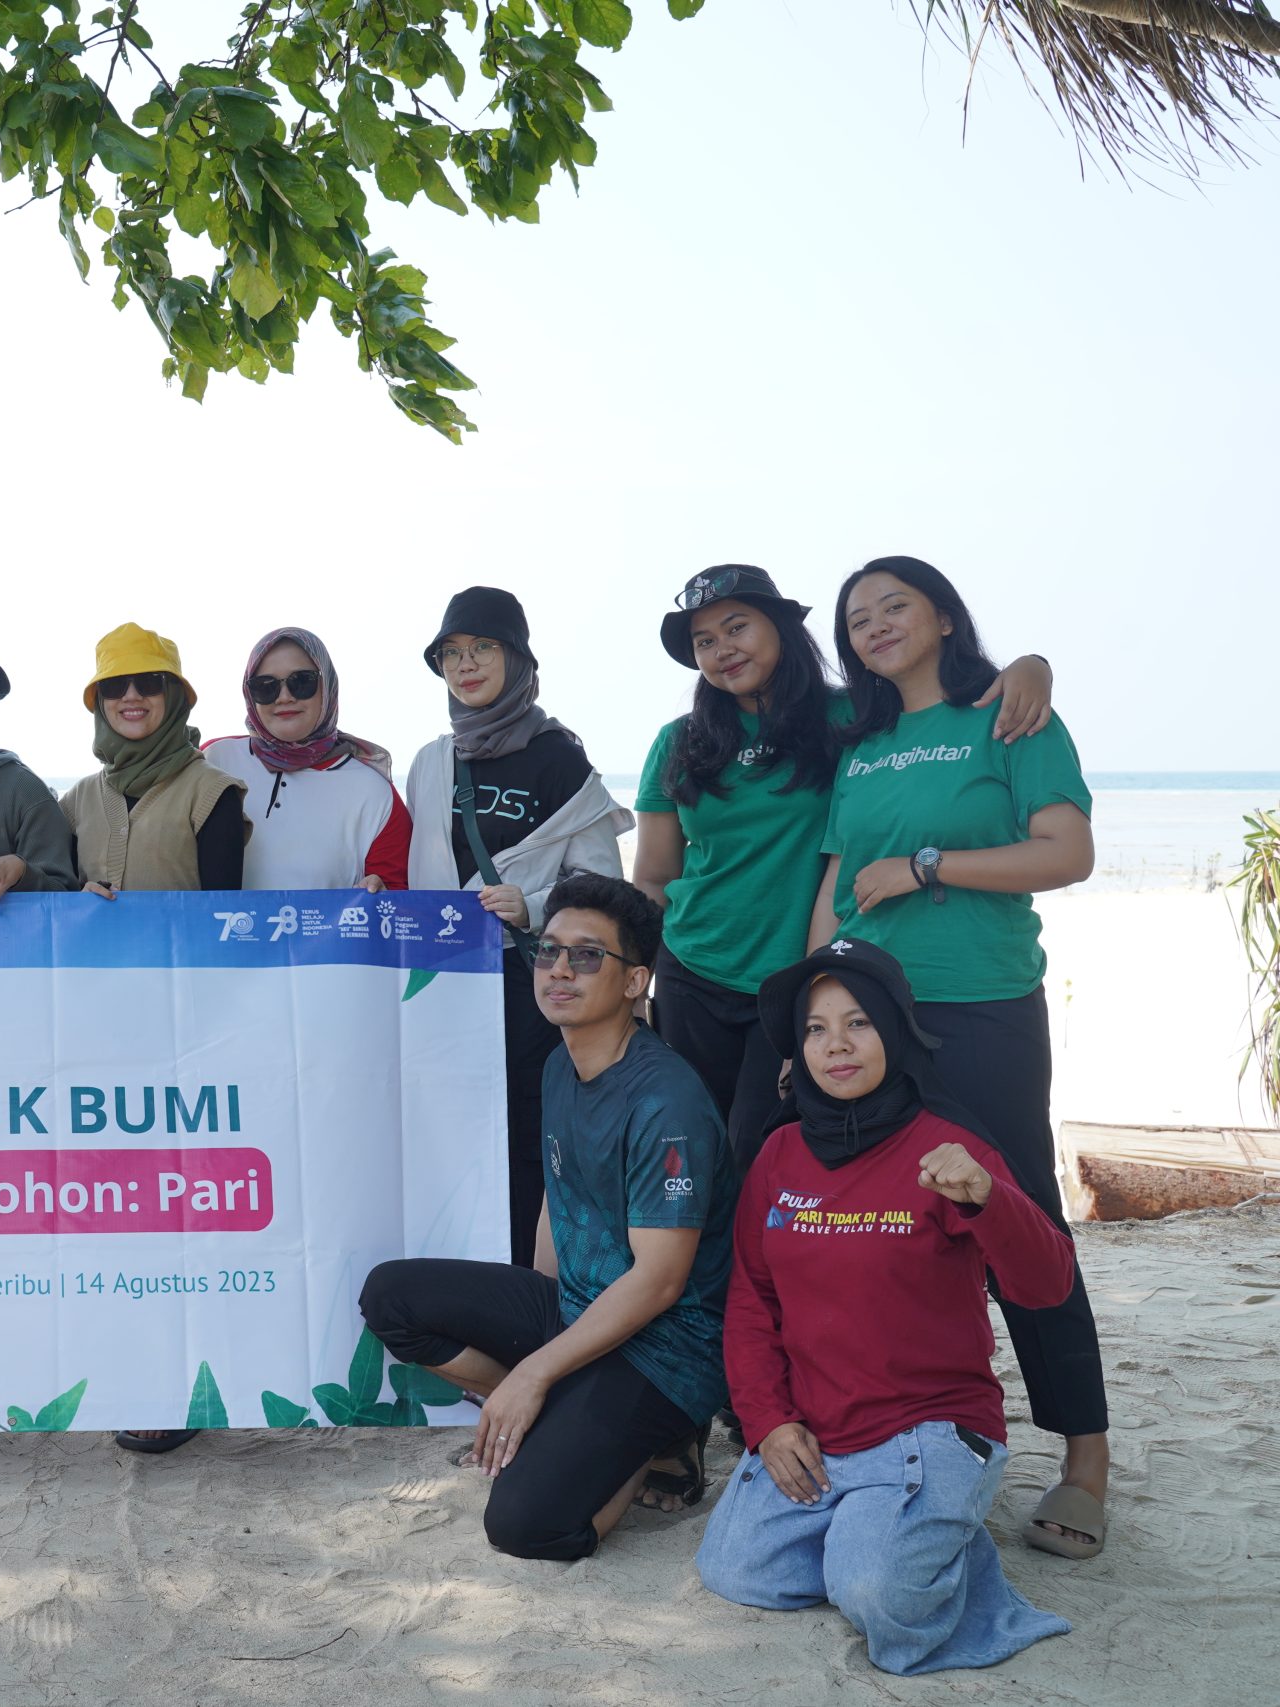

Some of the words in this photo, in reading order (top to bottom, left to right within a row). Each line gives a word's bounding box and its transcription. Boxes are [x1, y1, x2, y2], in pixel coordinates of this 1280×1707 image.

[266, 905, 298, 941] 78
[70, 1084, 241, 1134] BUMI
[158, 1168, 260, 1212] Pari
[664, 1178, 693, 1191] G20
[778, 1192, 822, 1209] PULAU
[792, 1222, 831, 1234] #SAVE
[835, 1224, 873, 1234] PULAU
[880, 1225, 912, 1234] PARI
[794, 1210, 823, 1224] PARI
[826, 1212, 860, 1225] TIDAK
[863, 1212, 876, 1223] DI
[879, 1211, 914, 1224] JUAL
[75, 1271, 105, 1295] 14
[113, 1271, 209, 1300] Agustus
[217, 1269, 276, 1293] 2023
